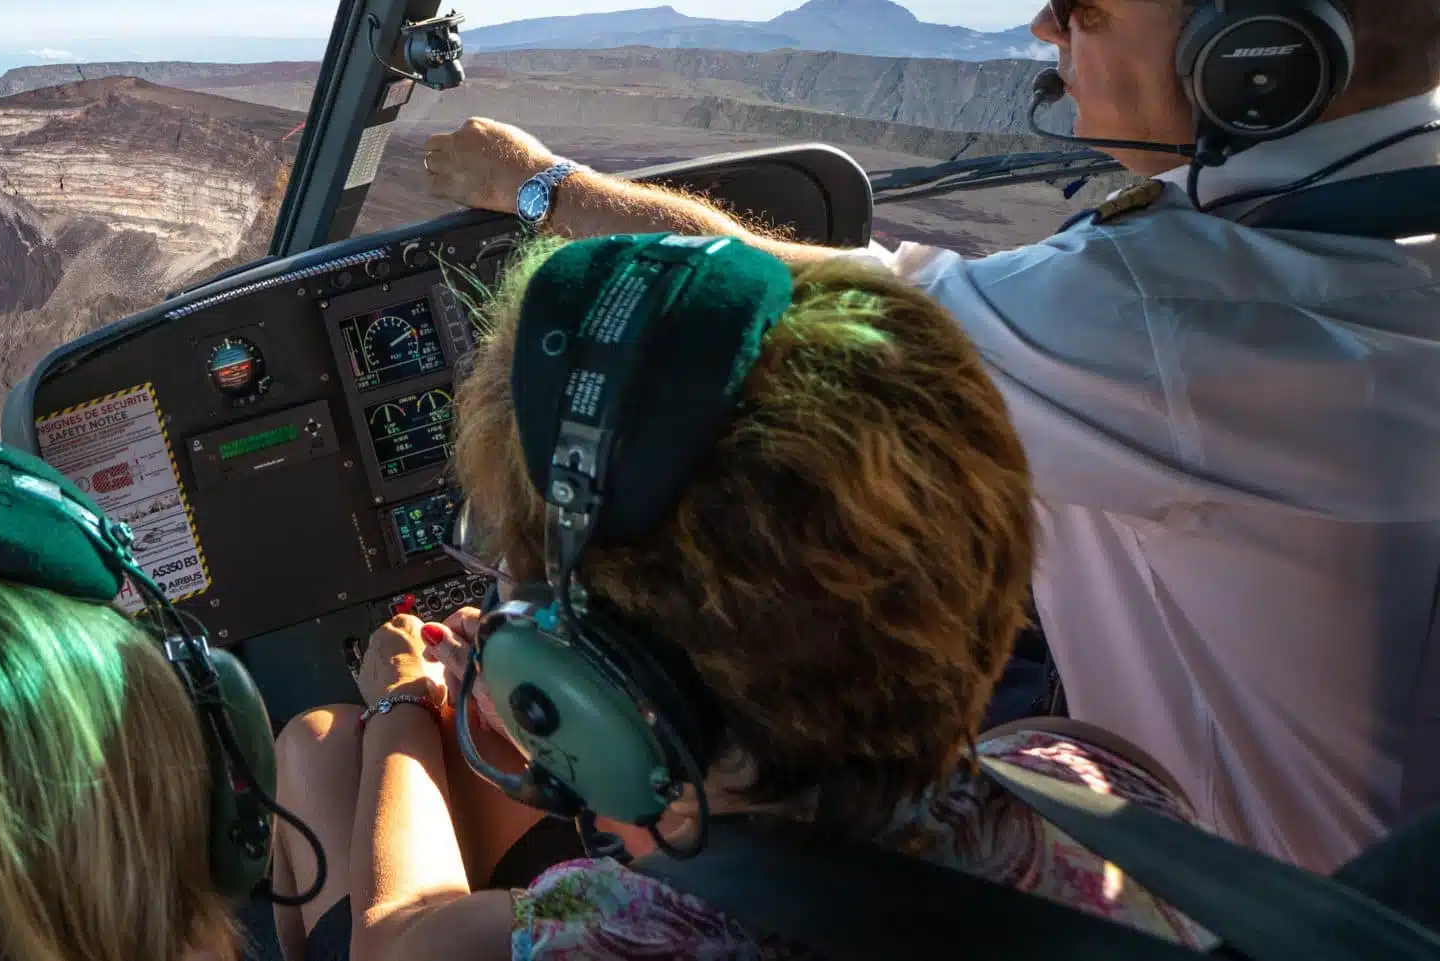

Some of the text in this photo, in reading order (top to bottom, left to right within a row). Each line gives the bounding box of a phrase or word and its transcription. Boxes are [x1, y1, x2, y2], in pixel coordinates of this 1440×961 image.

[1226, 44, 1298, 58] BOSE
[40, 415, 82, 434] NSIGNES
[84, 408, 99, 420] DE
[48, 410, 129, 443] SAFETY NOTICE
[152, 555, 198, 579] AS350 B3
[168, 571, 203, 589] AIRBUS
